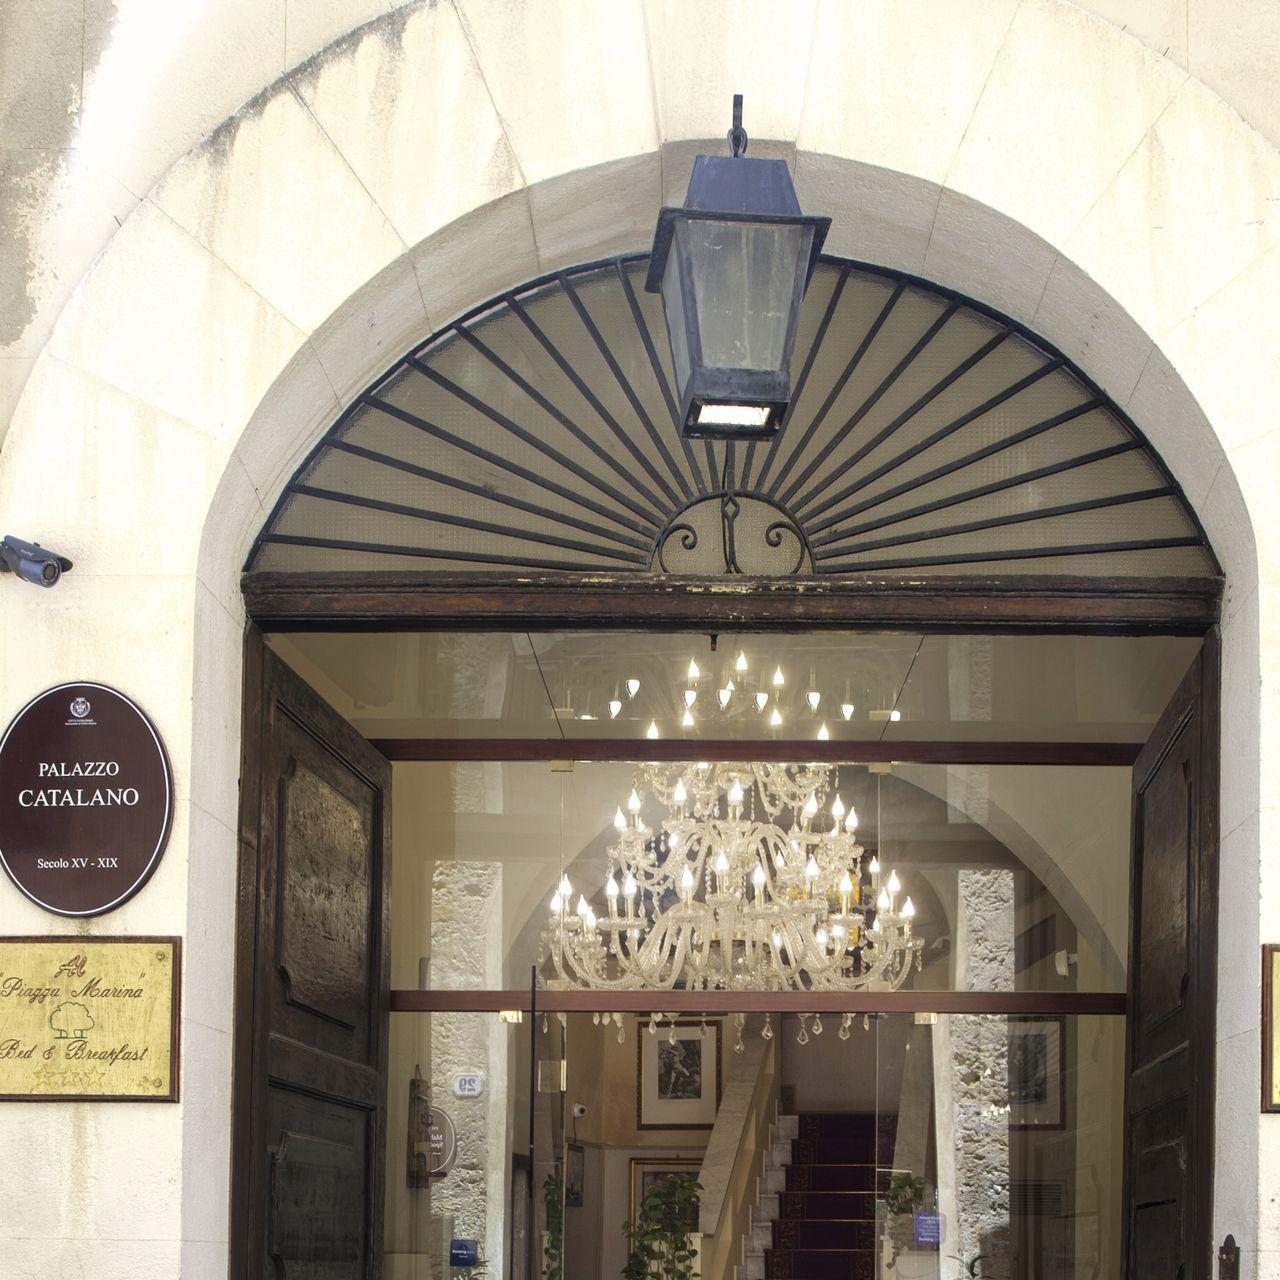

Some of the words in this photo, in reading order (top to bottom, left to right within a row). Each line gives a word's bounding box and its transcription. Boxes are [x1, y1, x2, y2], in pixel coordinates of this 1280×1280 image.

[38, 761, 120, 777] PALAZZO
[18, 788, 139, 807] CATALANO
[37, 858, 69, 869] Secolo
[71, 857, 88, 868] XV
[97, 857, 118, 868] XIX
[42, 1045, 57, 1060] &
[65, 1039, 149, 1066] Breakfast
